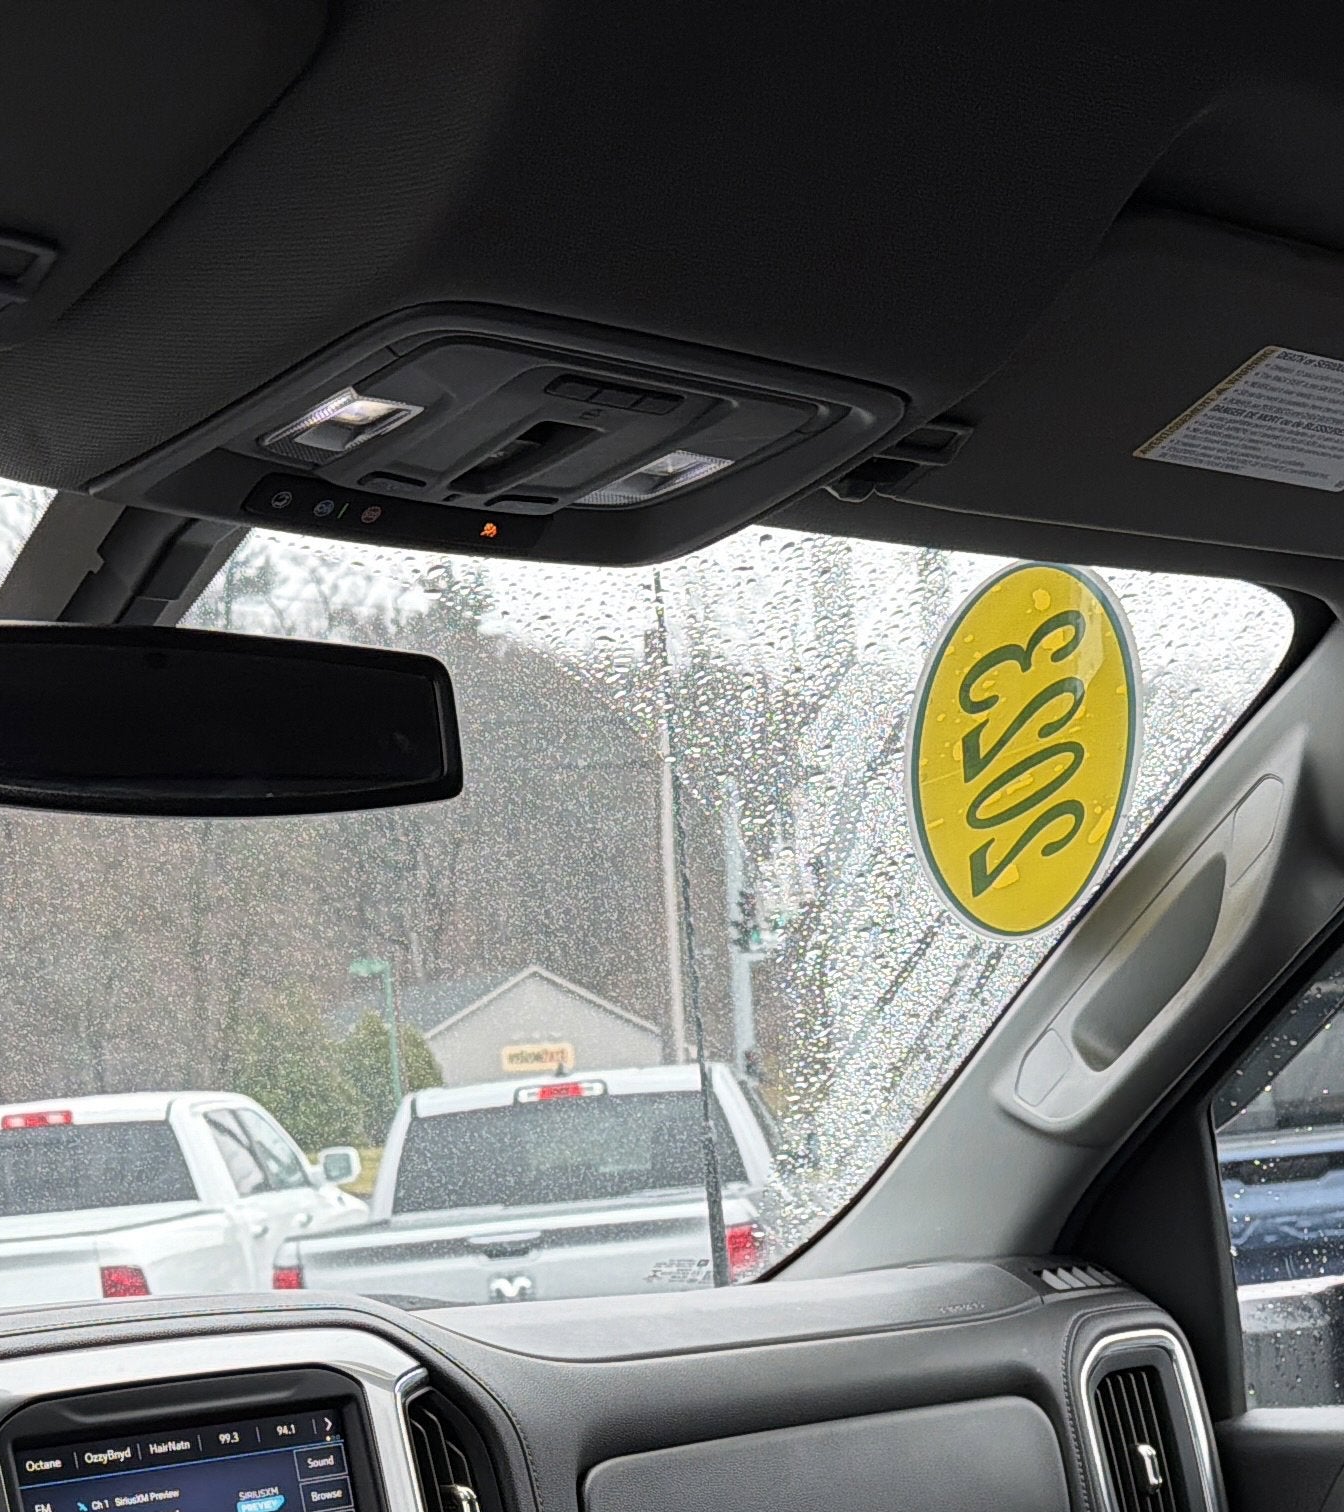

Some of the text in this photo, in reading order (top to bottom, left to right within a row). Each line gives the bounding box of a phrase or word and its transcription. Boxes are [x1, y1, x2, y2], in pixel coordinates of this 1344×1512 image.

[276, 1424, 296, 1436] 94.1
[218, 1431, 240, 1445] 99.3
[149, 1439, 191, 1455] HairNatn
[84, 1447, 131, 1465] OzzyBnyd
[307, 1455, 335, 1469] Sound
[25, 1457, 62, 1472] Octane
[91, 1501, 104, 1511] Ch
[150, 1489, 180, 1501] Preview
[239, 1486, 279, 1501] SIRIUSXM
[311, 1489, 343, 1502] Browse
